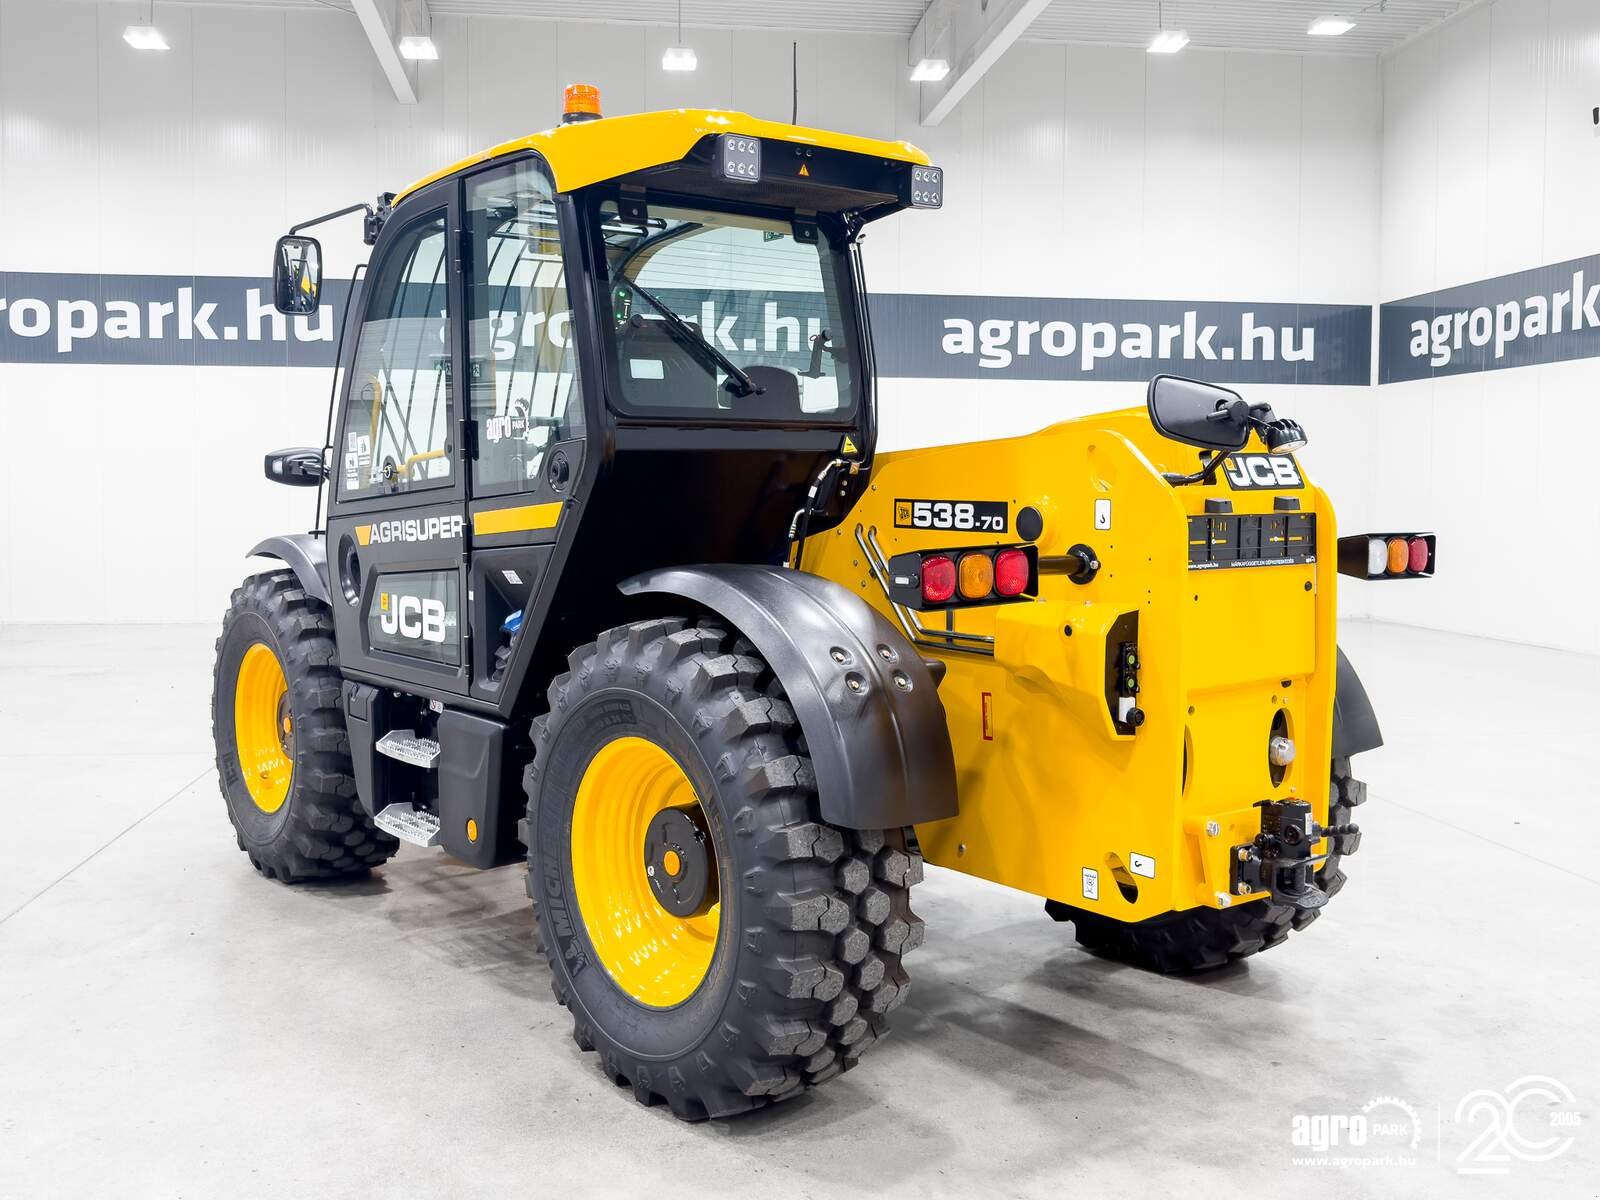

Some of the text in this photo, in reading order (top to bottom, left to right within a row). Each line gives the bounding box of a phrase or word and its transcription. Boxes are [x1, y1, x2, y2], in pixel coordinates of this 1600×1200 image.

[0, 287, 334, 353] opark.hu
[941, 310, 1315, 371] agropark.hu
[1228, 456, 1300, 487] JCB
[370, 515, 463, 545] AGRISUPER
[381, 594, 446, 642] JCB
